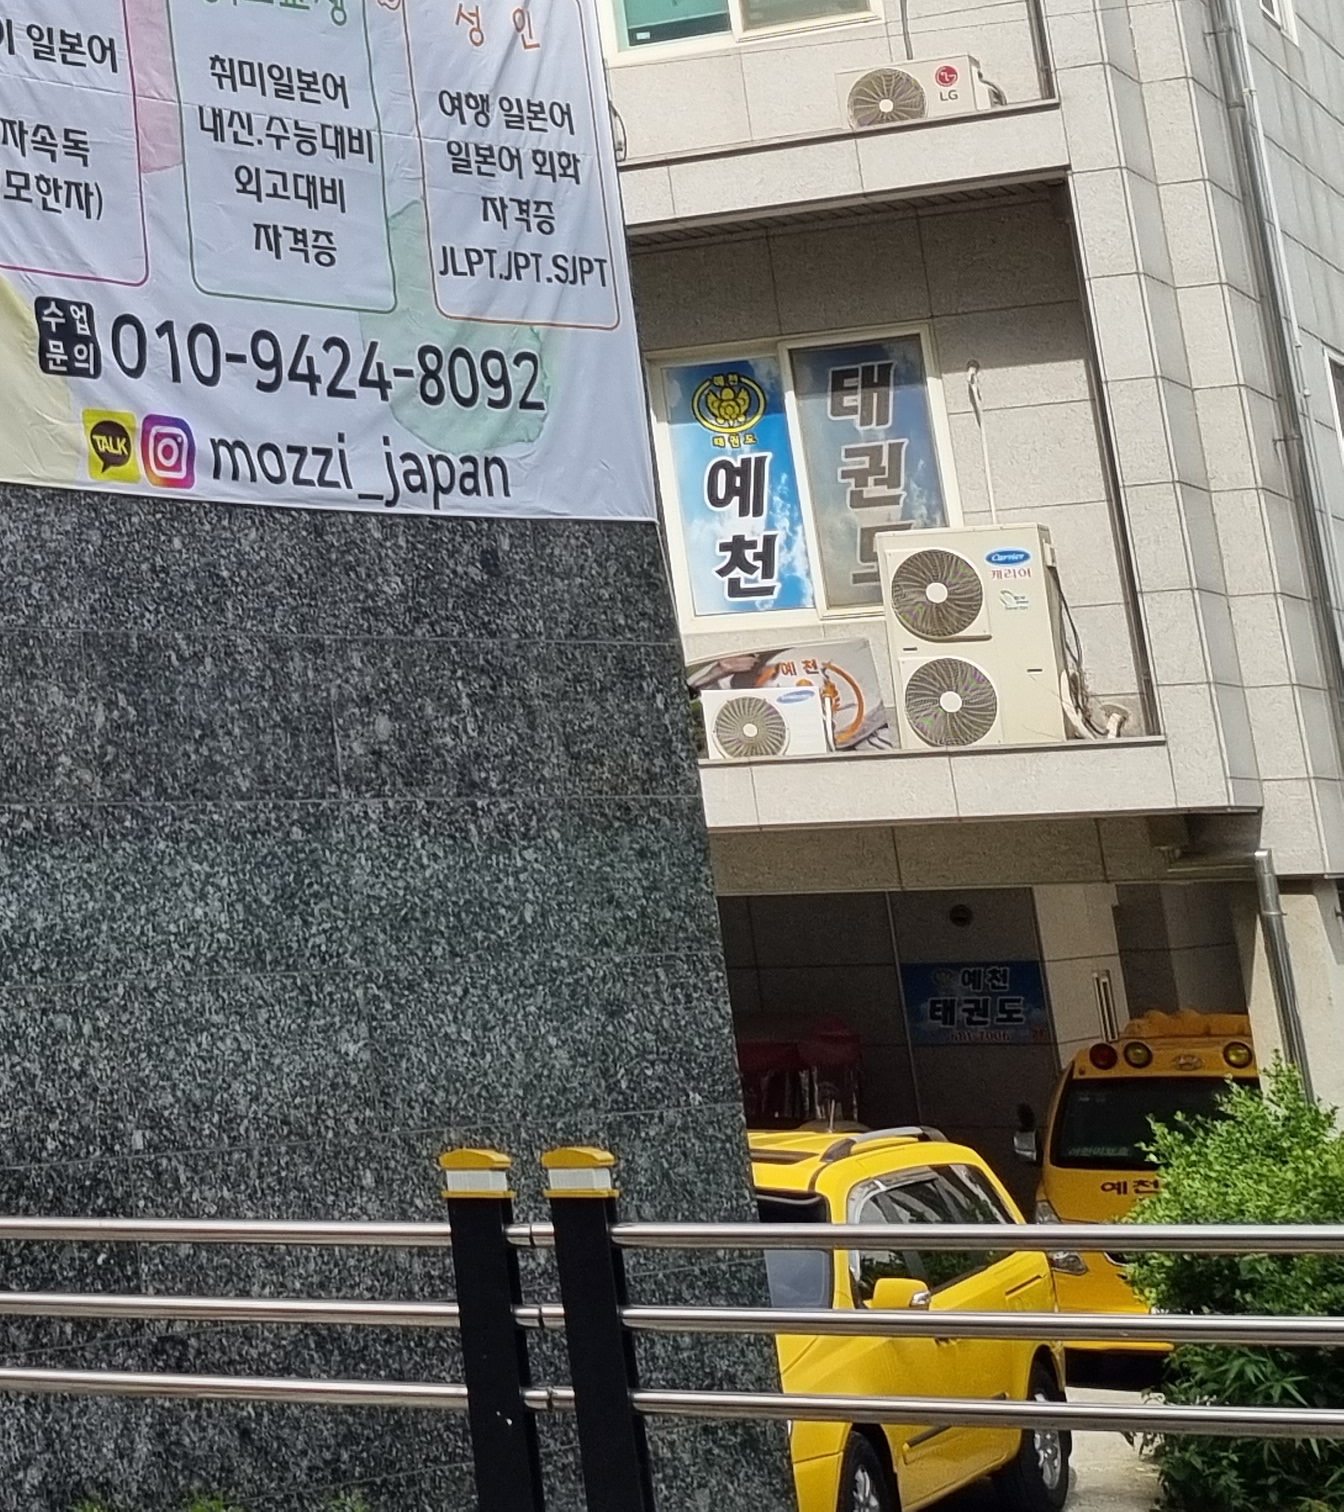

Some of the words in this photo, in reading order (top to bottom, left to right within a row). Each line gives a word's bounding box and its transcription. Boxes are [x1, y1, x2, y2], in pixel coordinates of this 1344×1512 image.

[26, 22, 118, 74] 일본어
[209, 53, 350, 110] 취미일본어
[939, 89, 959, 102] LG
[438, 89, 494, 133] 여행
[498, 94, 576, 136] 일본어
[447, 140, 526, 180] 일본어
[532, 145, 580, 185] 회화
[234, 163, 347, 214] 외고대비
[481, 194, 556, 236] 자격증
[253, 221, 337, 268] 자격증
[42, 301, 89, 334] 수업
[45, 340, 95, 377] 문의
[112, 312, 546, 413] 010-9424-8092
[92, 434, 129, 456] TALK
[212, 431, 512, 511] mozzi_japan
[705, 452, 783, 602] 예천
[961, 967, 1010, 992] 예천
[928, 996, 1025, 1028] 태권도
